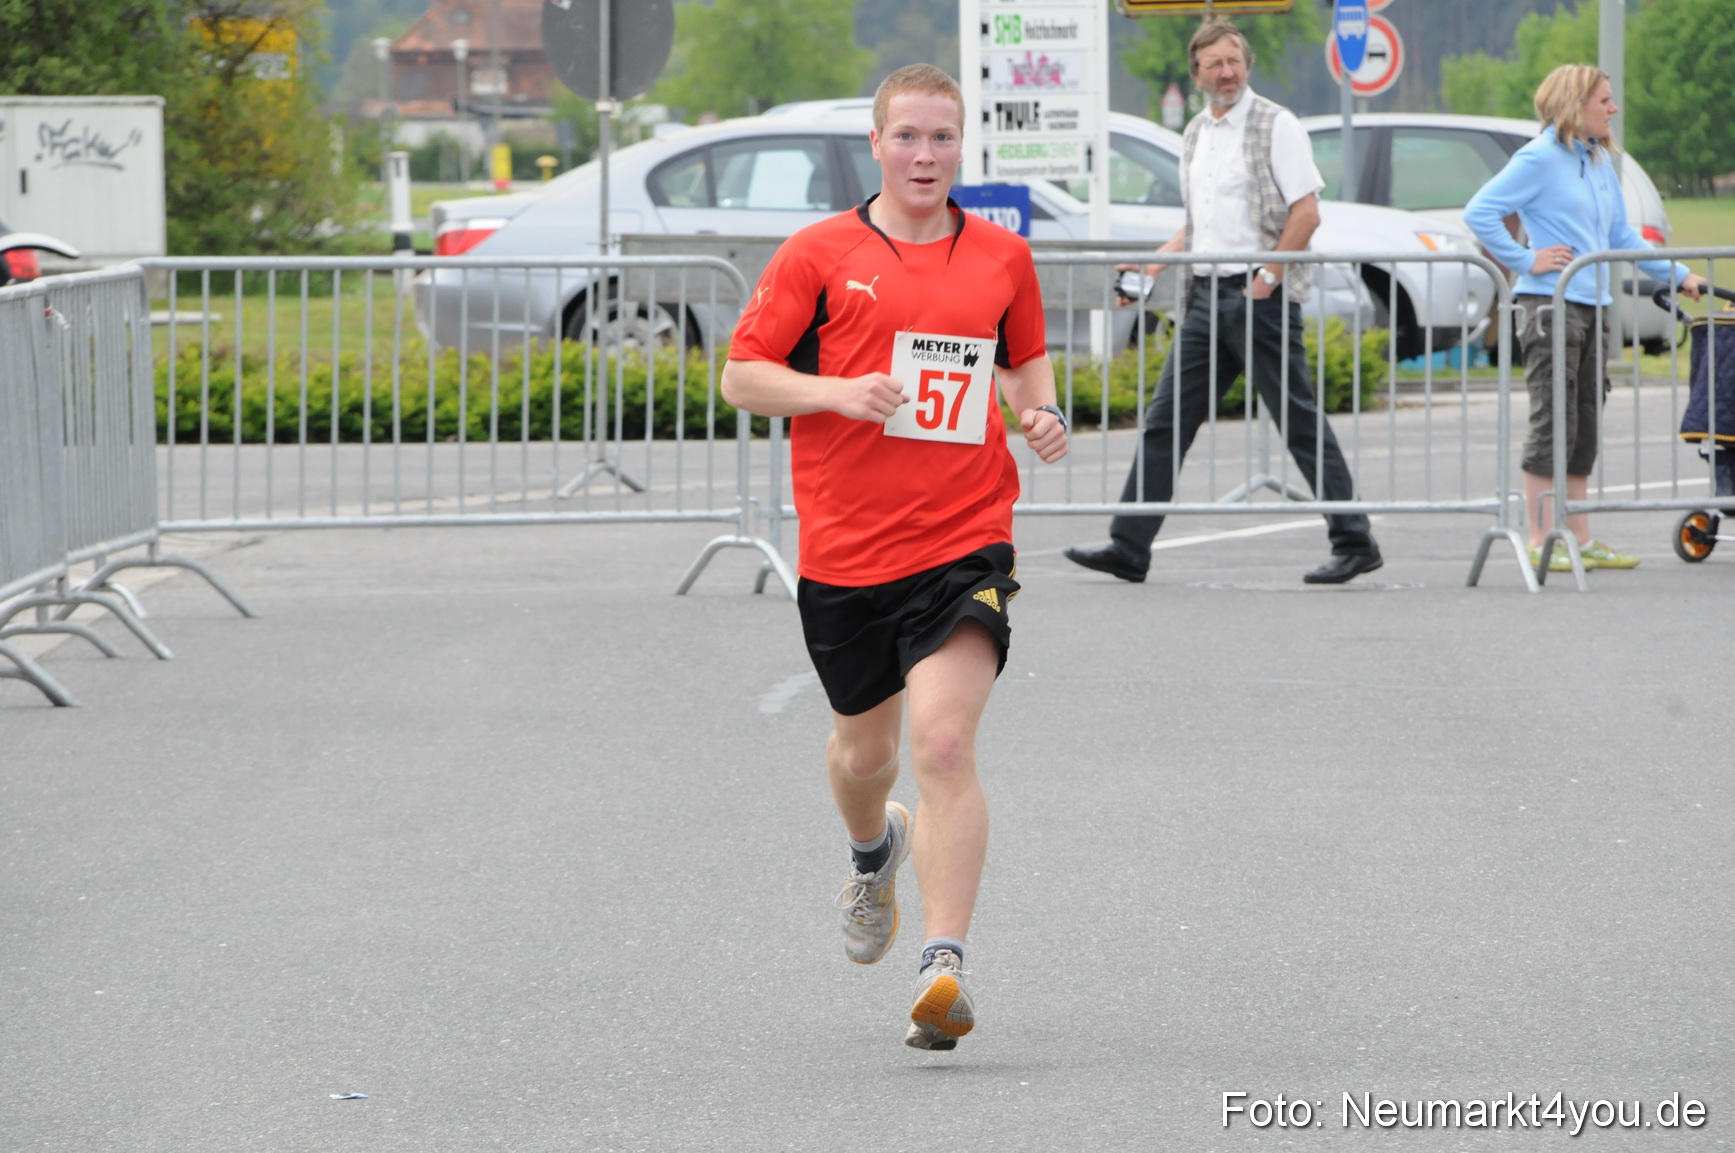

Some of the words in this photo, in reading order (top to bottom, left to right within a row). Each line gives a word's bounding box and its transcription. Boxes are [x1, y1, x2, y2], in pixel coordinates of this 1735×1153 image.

[995, 102, 1040, 131] THULE
[911, 338, 961, 354] MEYER
[911, 351, 961, 364] WERBUNG
[915, 369, 972, 431] 57
[972, 593, 1001, 613] adidas
